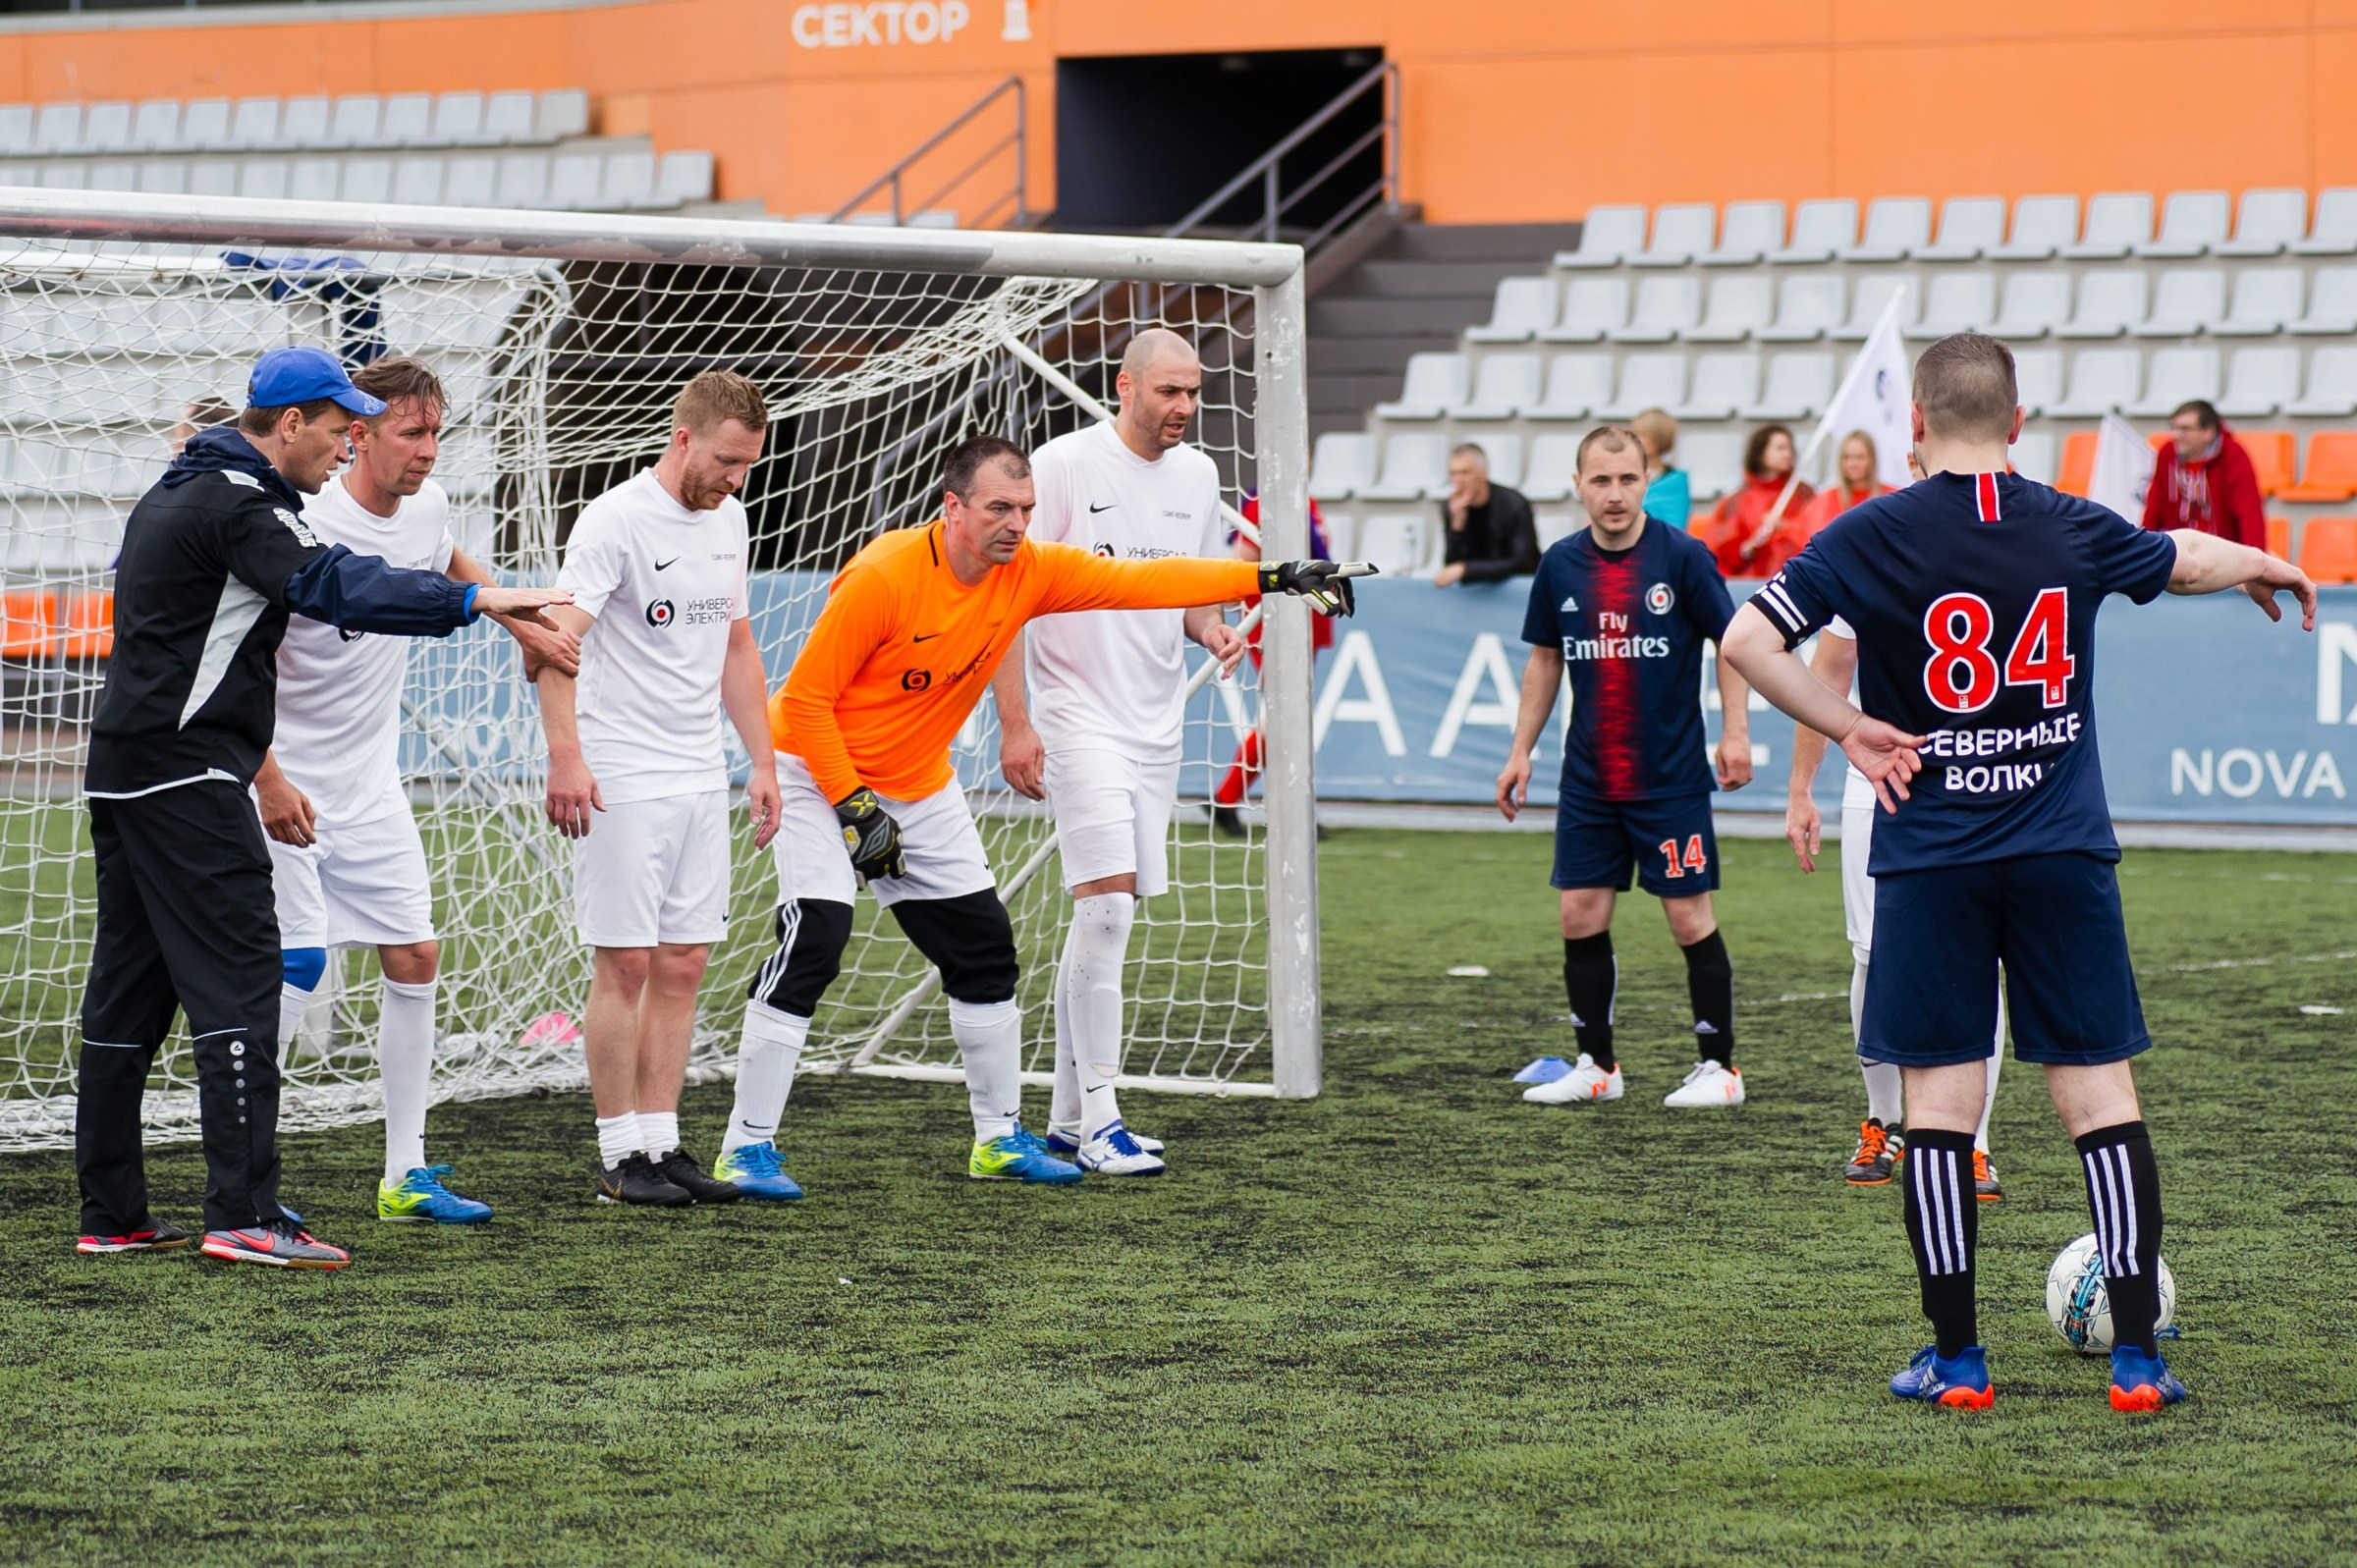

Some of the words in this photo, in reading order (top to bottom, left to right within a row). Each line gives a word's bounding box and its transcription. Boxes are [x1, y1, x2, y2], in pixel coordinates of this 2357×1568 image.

[792, 0, 970, 49] СЕКТОР
[1599, 611, 1628, 632] Fly
[1562, 633, 1671, 661] Emirates
[1924, 586, 2075, 713] 84
[2170, 746, 2346, 800] NOVA
[1659, 834, 1707, 879] 14
